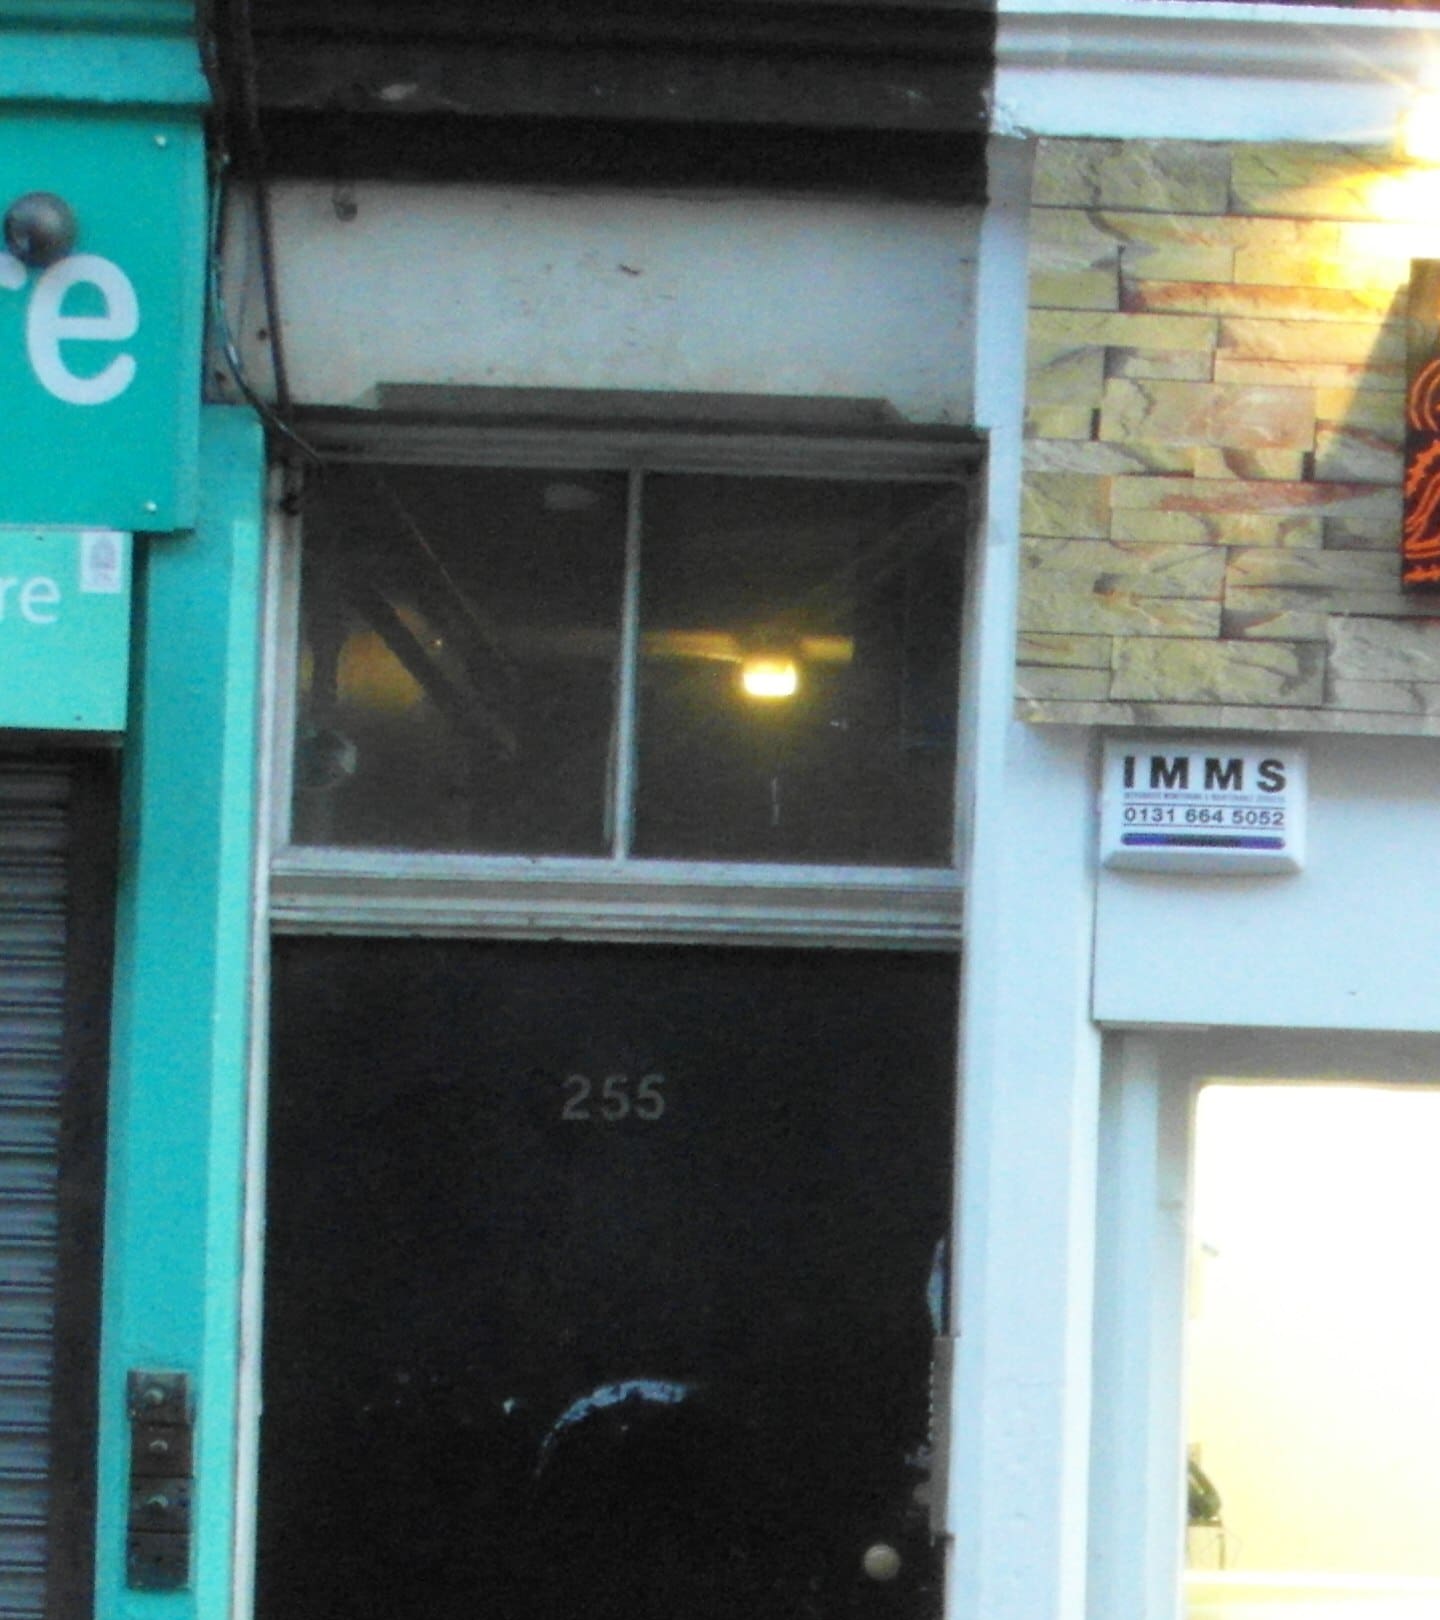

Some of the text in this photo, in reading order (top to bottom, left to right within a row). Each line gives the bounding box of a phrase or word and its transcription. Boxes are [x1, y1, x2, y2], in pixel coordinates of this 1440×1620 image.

[1123, 756, 1287, 793] IMMS
[1124, 807, 1285, 826] 0131 664 5052
[560, 1073, 667, 1121] 255
